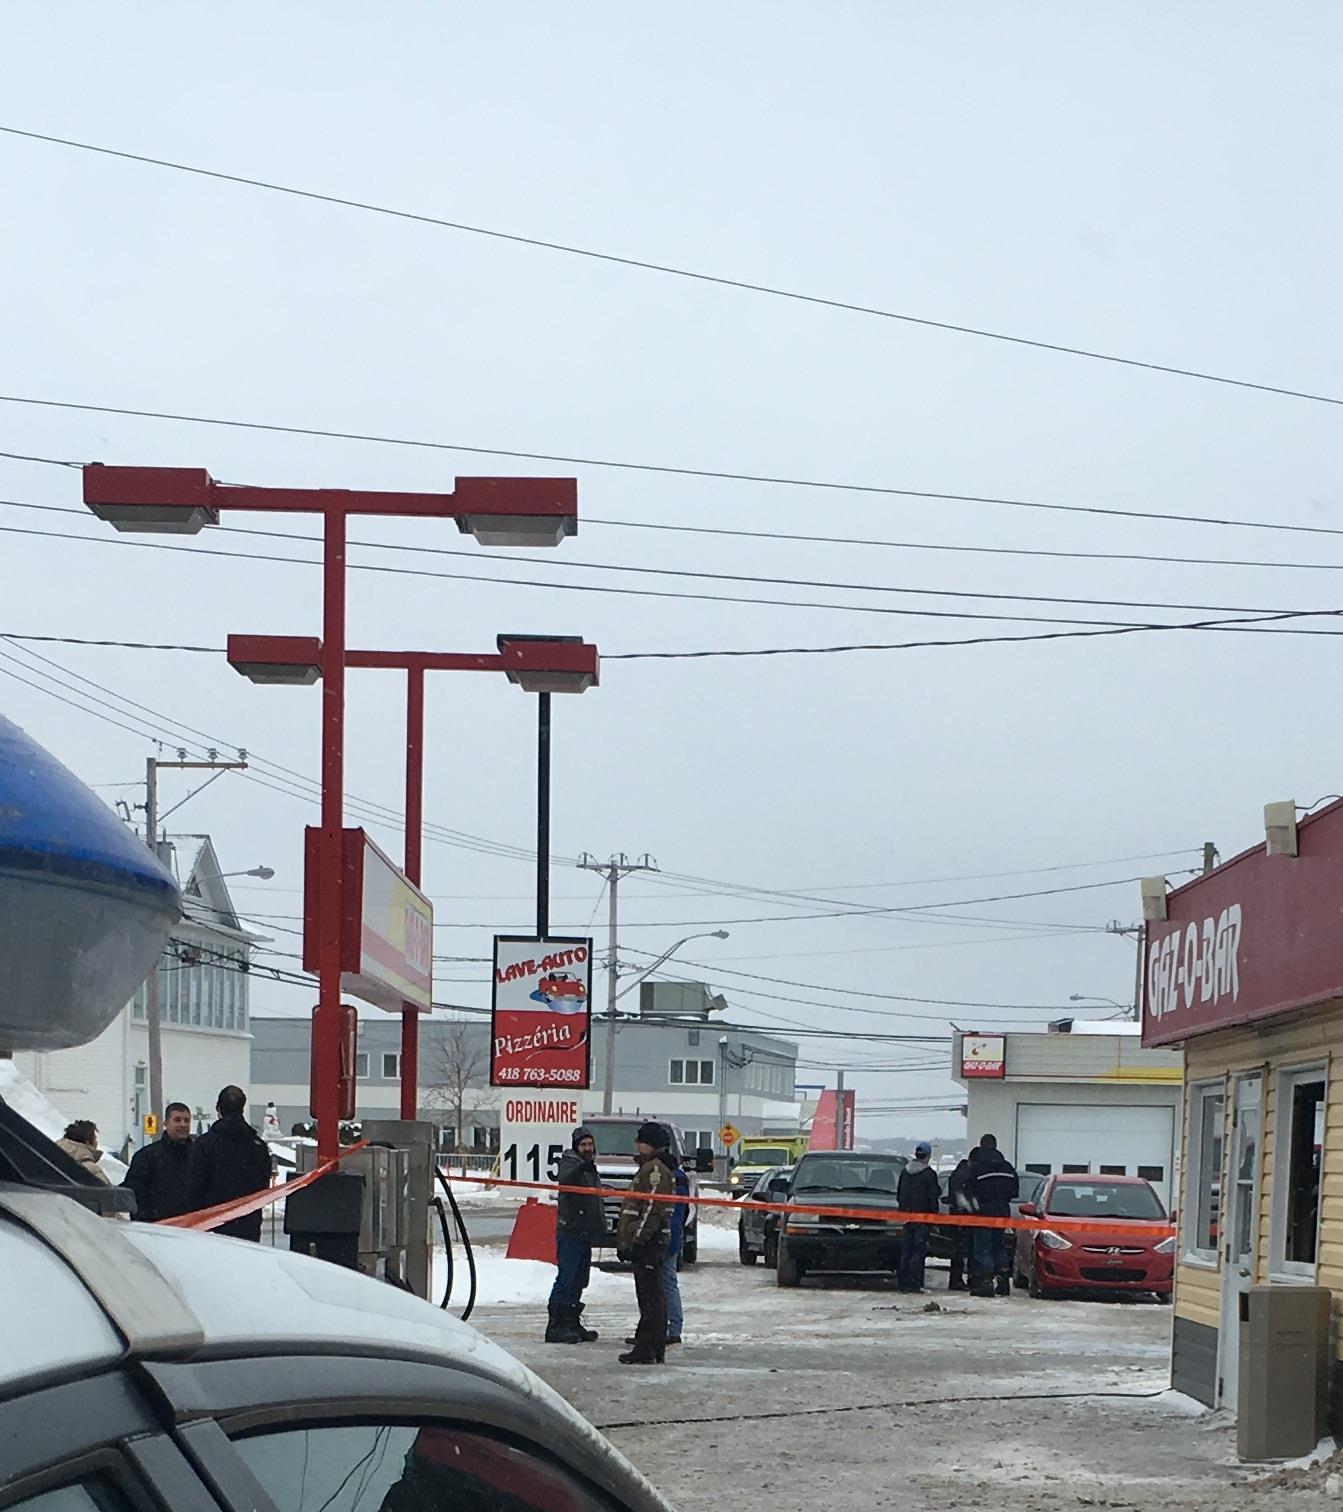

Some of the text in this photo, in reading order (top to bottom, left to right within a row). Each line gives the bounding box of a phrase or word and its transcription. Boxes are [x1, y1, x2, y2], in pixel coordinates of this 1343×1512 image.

[496, 946, 588, 984] LAVE-AUTO
[1148, 903, 1242, 1023] GAZ-O-BAR
[494, 1023, 571, 1059] Pizzéria
[498, 1067, 581, 1082] 418 763-5088
[506, 1099, 578, 1123] ORDINAIRE
[504, 1143, 564, 1182] 115
